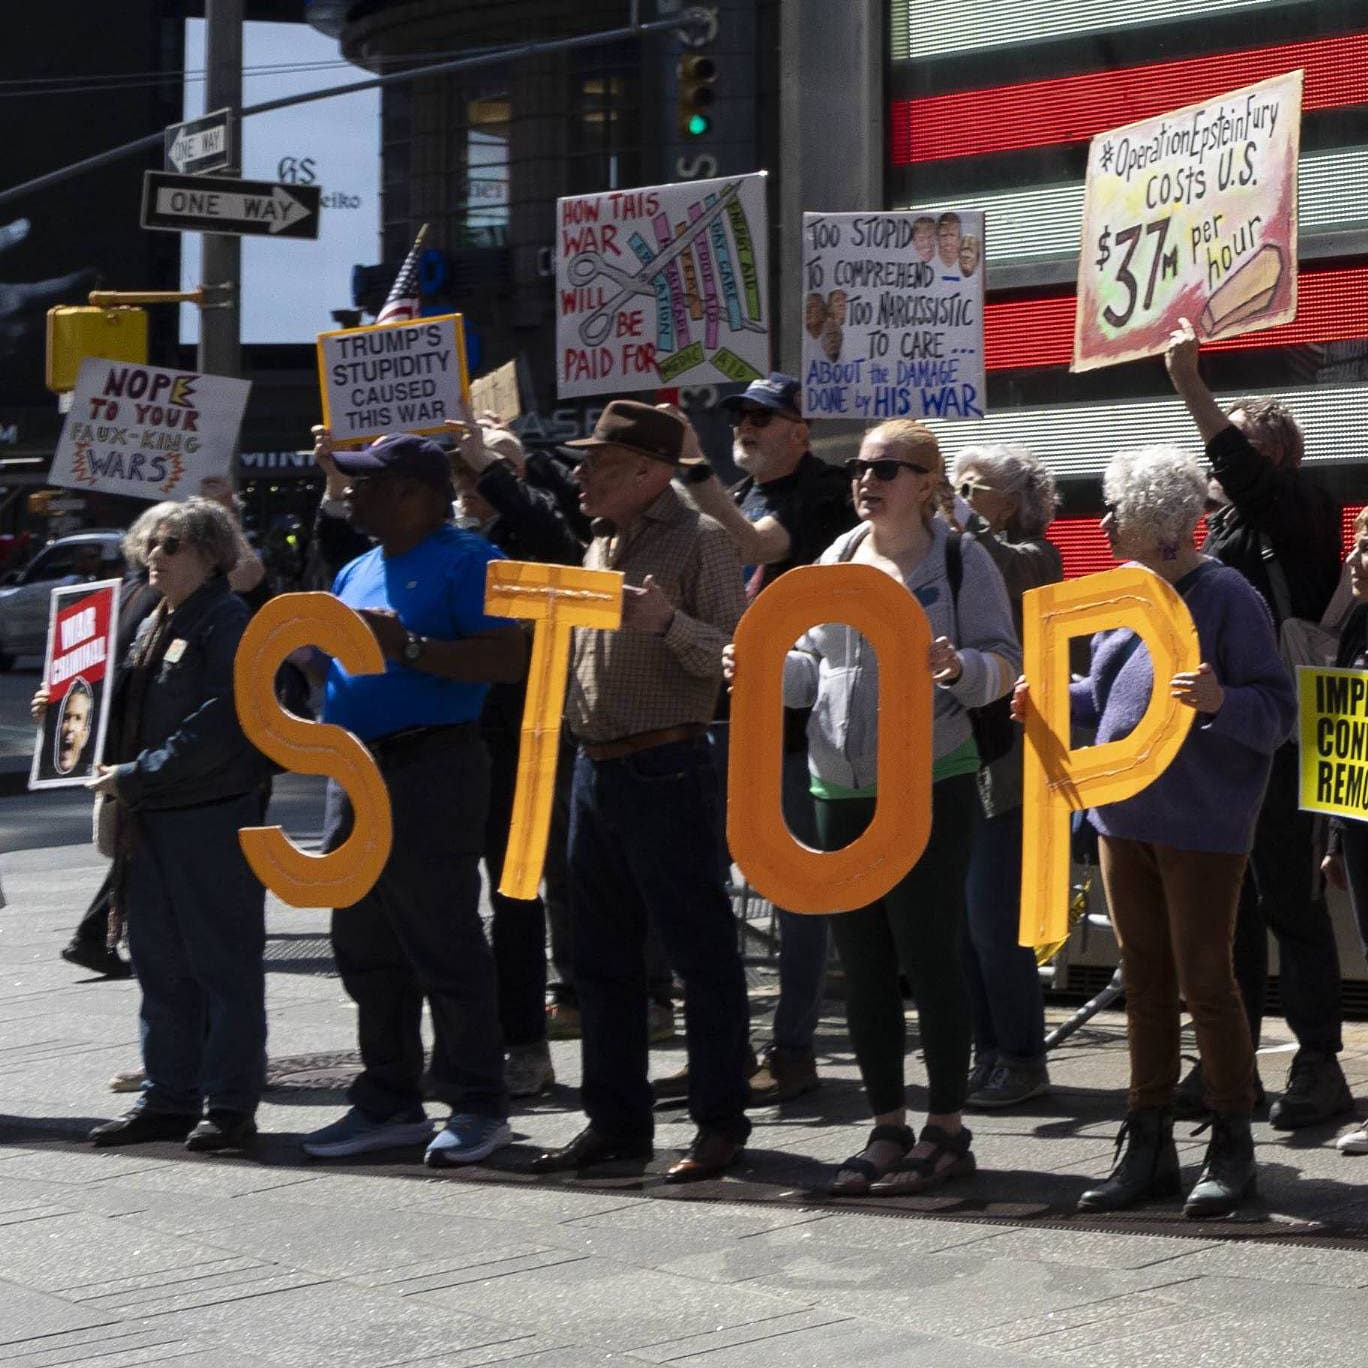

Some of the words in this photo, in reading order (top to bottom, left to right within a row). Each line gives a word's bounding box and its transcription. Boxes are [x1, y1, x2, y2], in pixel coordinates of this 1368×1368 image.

[174, 138, 194, 162] ONE
[201, 130, 220, 151] WAY
[1099, 94, 1280, 181] #OperationEpsteinFury
[278, 156, 317, 184] GS
[1146, 169, 1206, 209] costs
[1218, 141, 1258, 192] U.S.
[170, 191, 220, 215] ONE
[243, 197, 297, 220] WAY
[320, 191, 361, 209] eiko
[562, 198, 600, 227] HOW
[608, 192, 659, 221] THIS
[563, 224, 622, 257] WAR
[806, 217, 840, 250] TOO
[1191, 213, 1223, 264] per
[711, 222, 726, 250] DAY
[720, 260, 738, 300] CARE
[1207, 215, 1262, 290] hour
[740, 261, 756, 290] AID
[806, 255, 824, 290] TO
[834, 259, 935, 289] COMPREHEND
[560, 287, 607, 315] WILL
[847, 295, 873, 327] TOO
[877, 292, 974, 328] NARCISSISTIC
[615, 310, 644, 338] BE
[335, 324, 442, 361] TRUMP'S
[867, 330, 889, 359] TO
[901, 331, 945, 359] CARE
[332, 350, 451, 387] STUPIDITY
[563, 347, 614, 382] PAID
[622, 342, 663, 376] FOR
[806, 358, 865, 385] ABOUT
[868, 365, 889, 383] the
[896, 359, 960, 388] DAMAGE
[102, 368, 202, 408] NOPE
[350, 379, 436, 408] CAUSED
[808, 386, 848, 413] DONE
[855, 394, 872, 416] by
[874, 385, 910, 418] HIS
[920, 383, 984, 417] WAR
[89, 397, 119, 421] TO
[134, 403, 200, 431] YOUR
[345, 410, 393, 432] THIS
[400, 401, 446, 424] WAR
[69, 422, 201, 454] FAUX-KING
[86, 448, 169, 483] WARS
